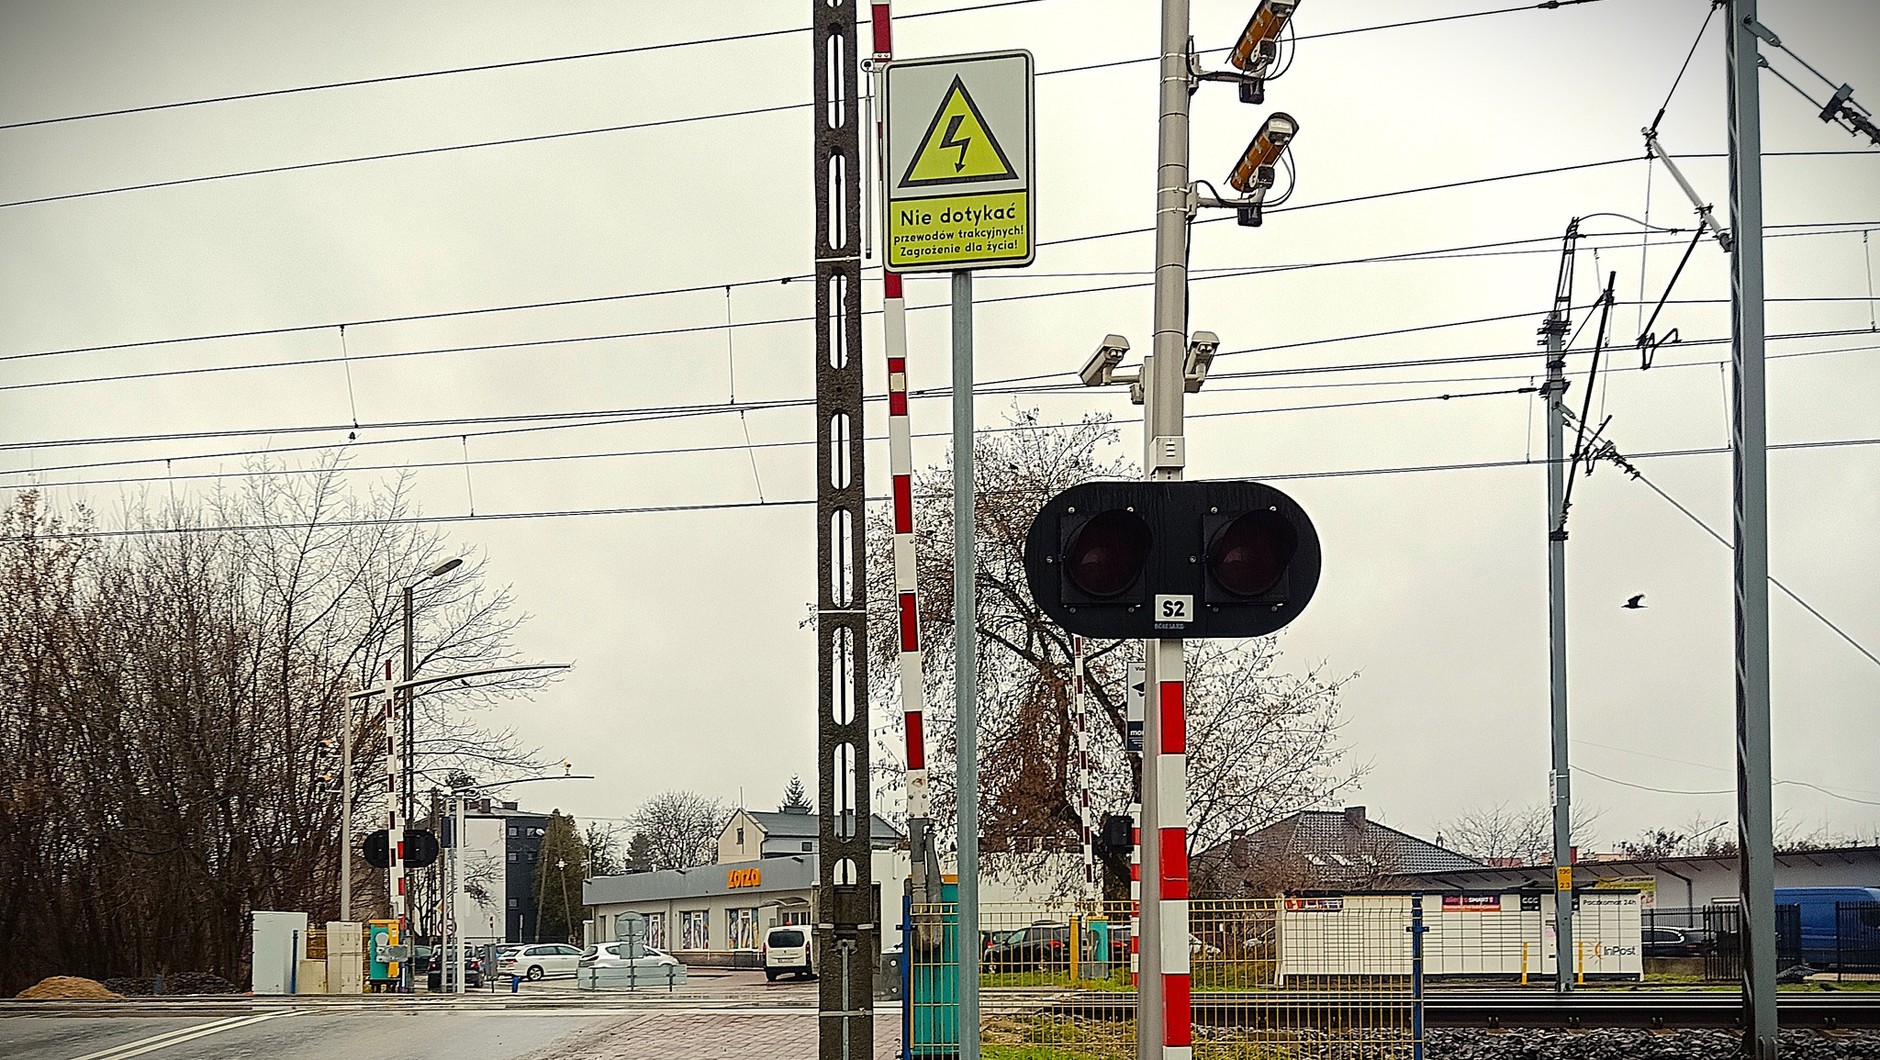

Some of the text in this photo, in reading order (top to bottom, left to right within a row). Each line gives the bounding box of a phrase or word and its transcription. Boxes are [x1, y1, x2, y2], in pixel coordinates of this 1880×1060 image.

[901, 202, 1016, 226] Nie dotykać
[893, 225, 1024, 245] przewodów trakcyjnych!
[900, 239, 1018, 258] Zagrożenie dla życia!
[1162, 599, 1185, 617] S2
[1604, 945, 1636, 956] InPost
